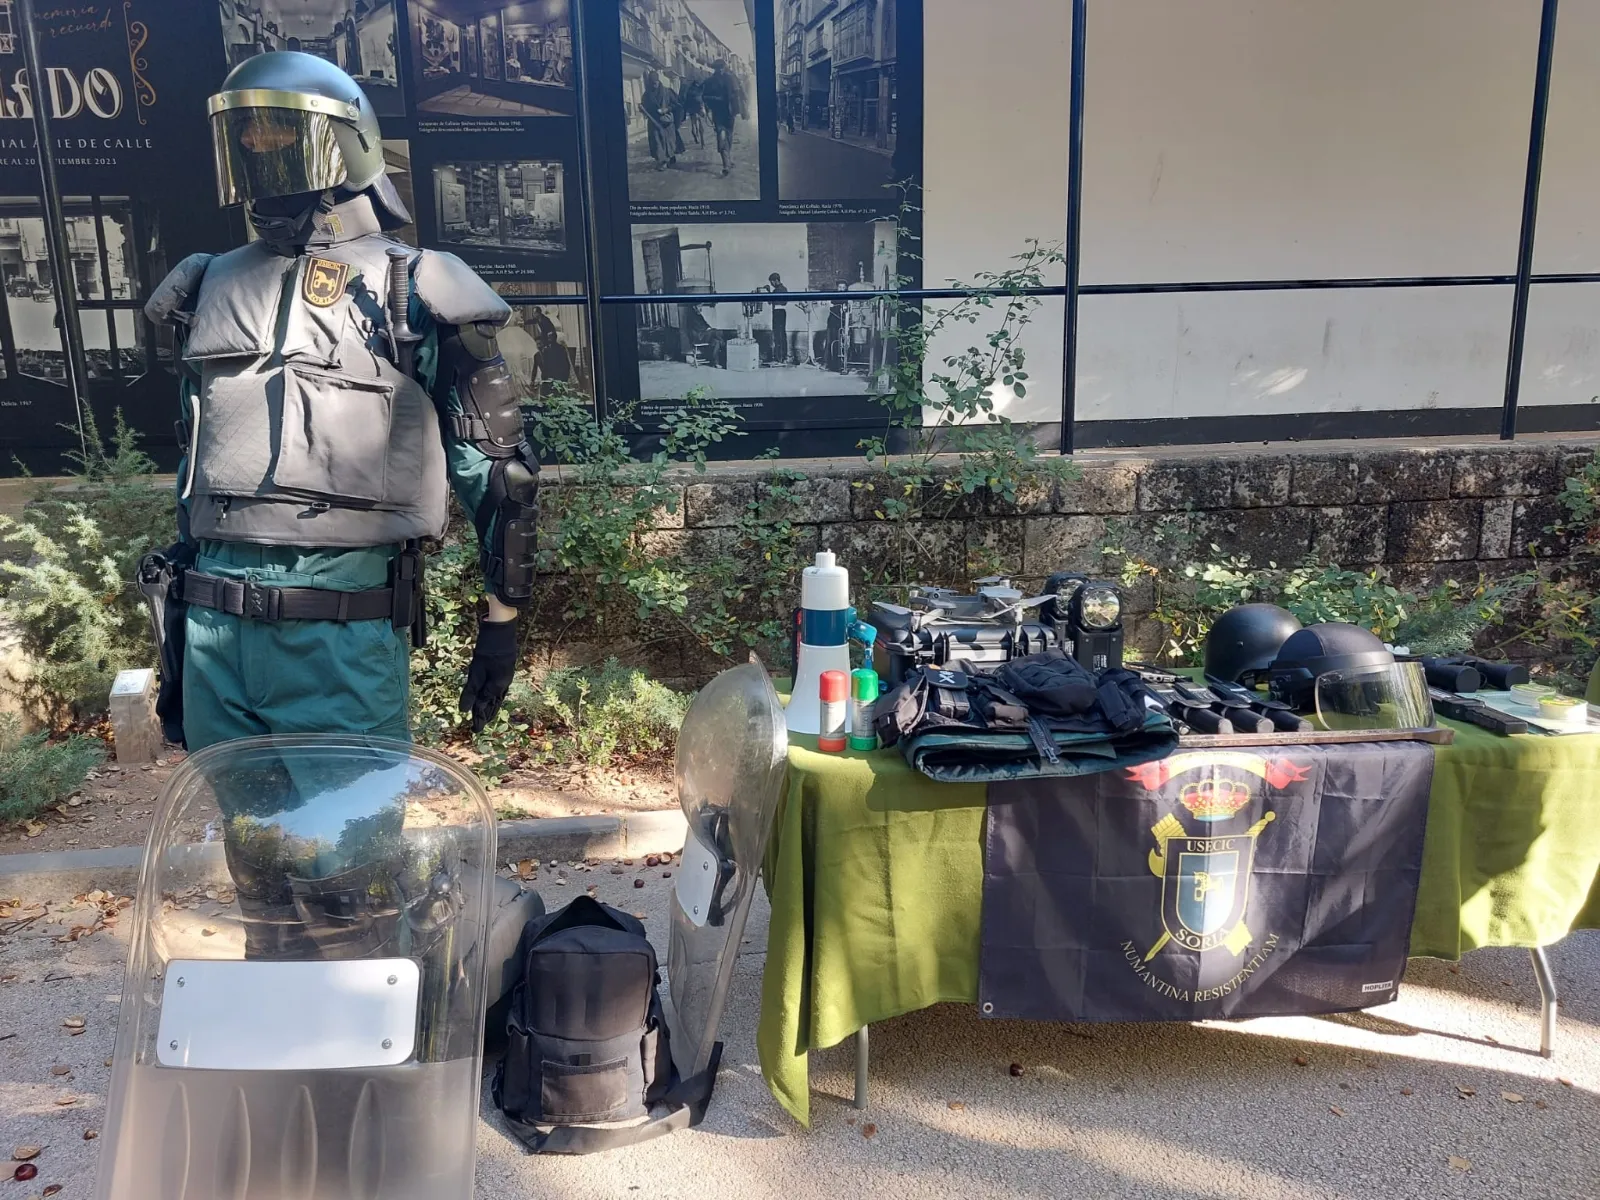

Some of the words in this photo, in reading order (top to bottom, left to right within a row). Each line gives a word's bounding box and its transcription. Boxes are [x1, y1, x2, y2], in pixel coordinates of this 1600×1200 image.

[50, 7, 112, 38] recuerdo
[57, 138, 72, 149] IE
[78, 138, 97, 149] DE
[103, 138, 152, 149] CALLE
[1187, 838, 1236, 853] USECIC
[1175, 928, 1229, 949] SORIA
[1120, 940, 1189, 1002] NUMANTINA
[1194, 932, 1280, 1003] RESISTENTIAM
